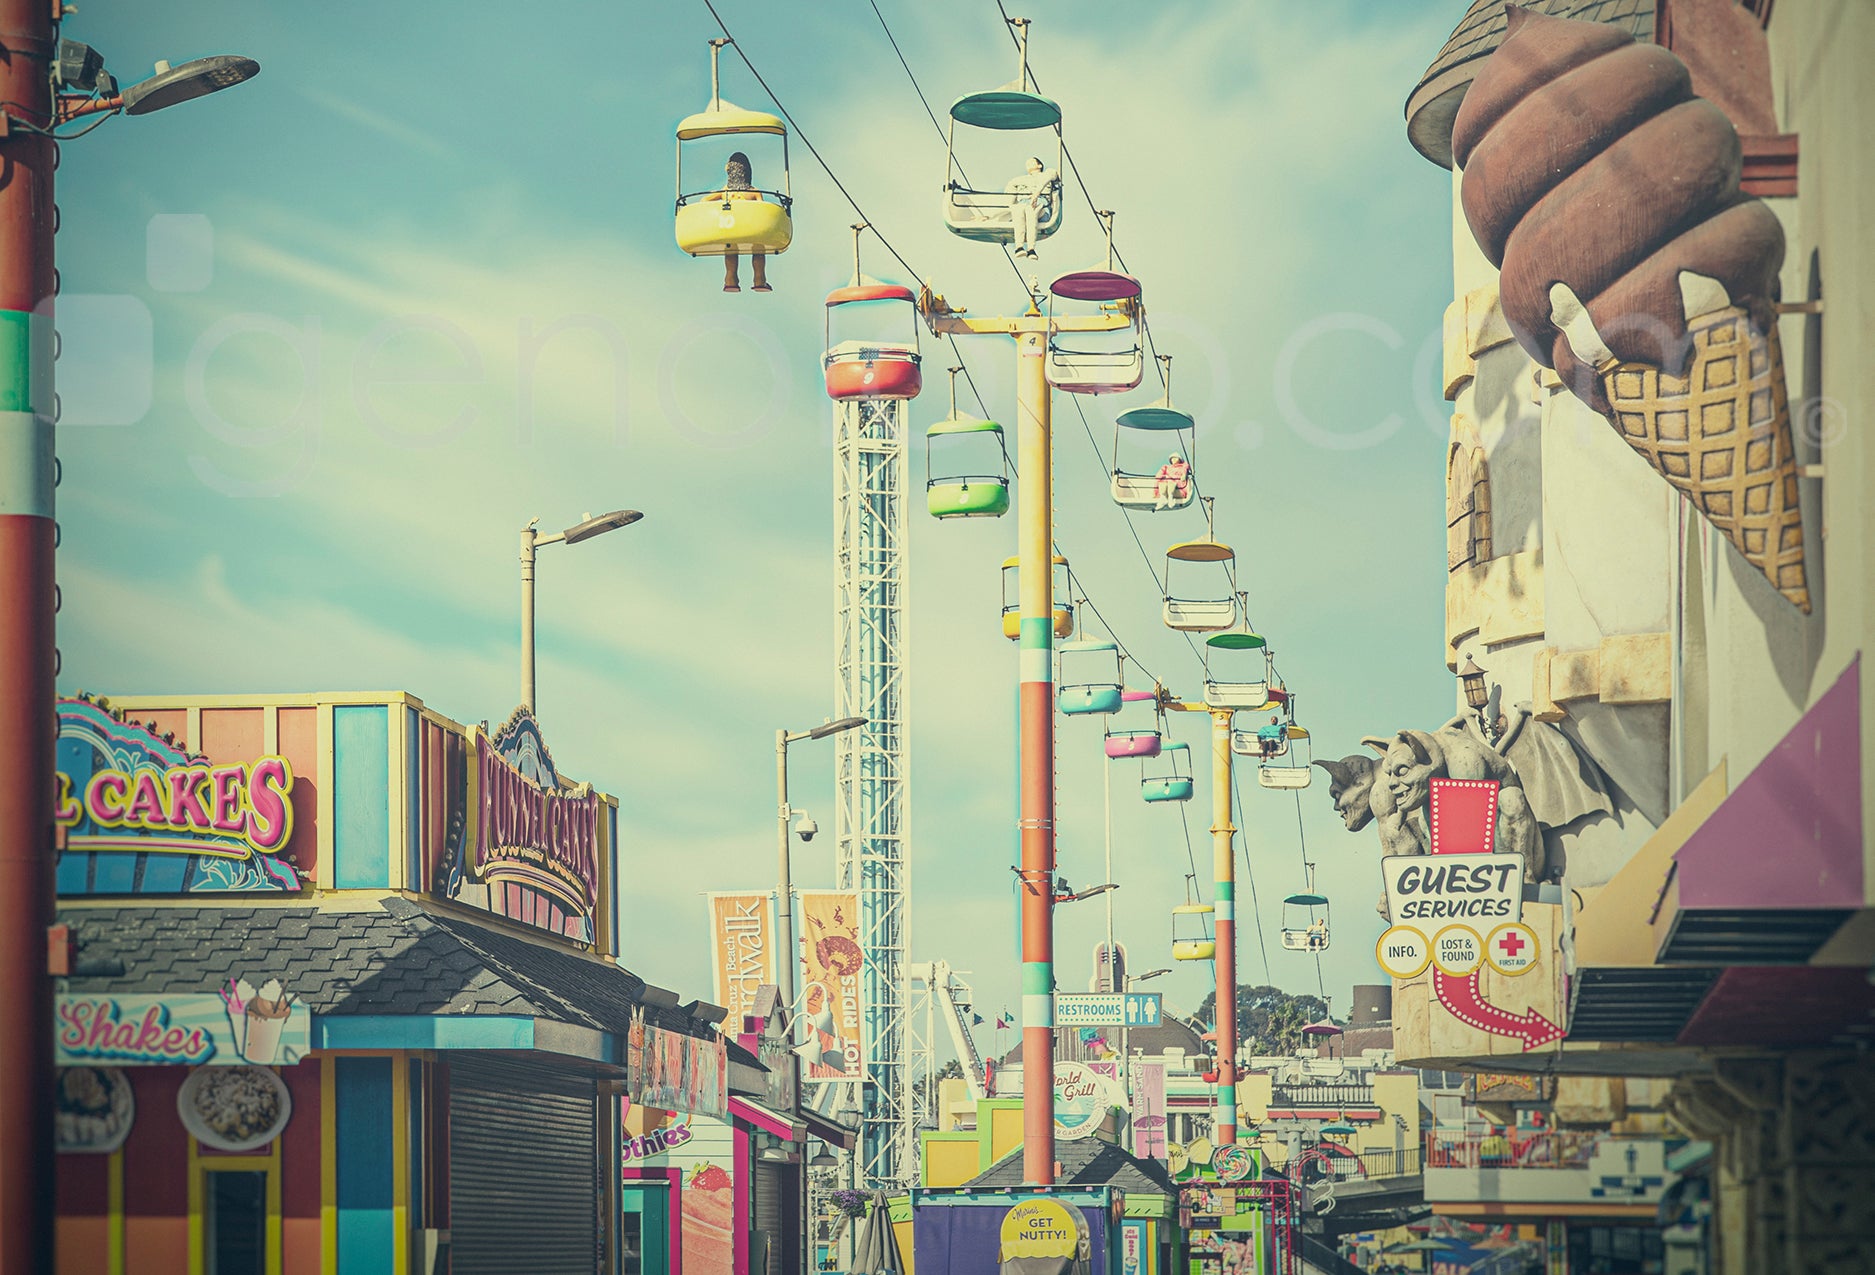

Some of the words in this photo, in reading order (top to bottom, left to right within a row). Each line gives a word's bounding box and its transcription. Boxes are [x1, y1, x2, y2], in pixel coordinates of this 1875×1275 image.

[1028, 336, 1037, 346] 4
[863, 371, 875, 385] 9
[88, 757, 291, 851] CAKES
[1396, 863, 1518, 895] GUEST
[1400, 898, 1512, 919] SERVICES
[724, 936, 737, 971] Beach
[1388, 945, 1418, 958] INFO.
[1441, 939, 1463, 950] LOST
[1464, 939, 1473, 949] &
[1442, 951, 1475, 961] FOUND
[727, 984, 738, 1014] Cruz
[841, 974, 857, 1028] RIDES
[1058, 1004, 1121, 1016] RESTROOMS
[59, 999, 208, 1060] Shakes
[728, 1016, 738, 1043] anta
[843, 1036, 860, 1075] HOT
[1053, 1071, 1082, 1087] orld
[1135, 1065, 1144, 1089] SAND
[1064, 1083, 1096, 1102] Grill
[1028, 1218, 1053, 1228] GET
[1019, 1230, 1067, 1241] NUTTY!
